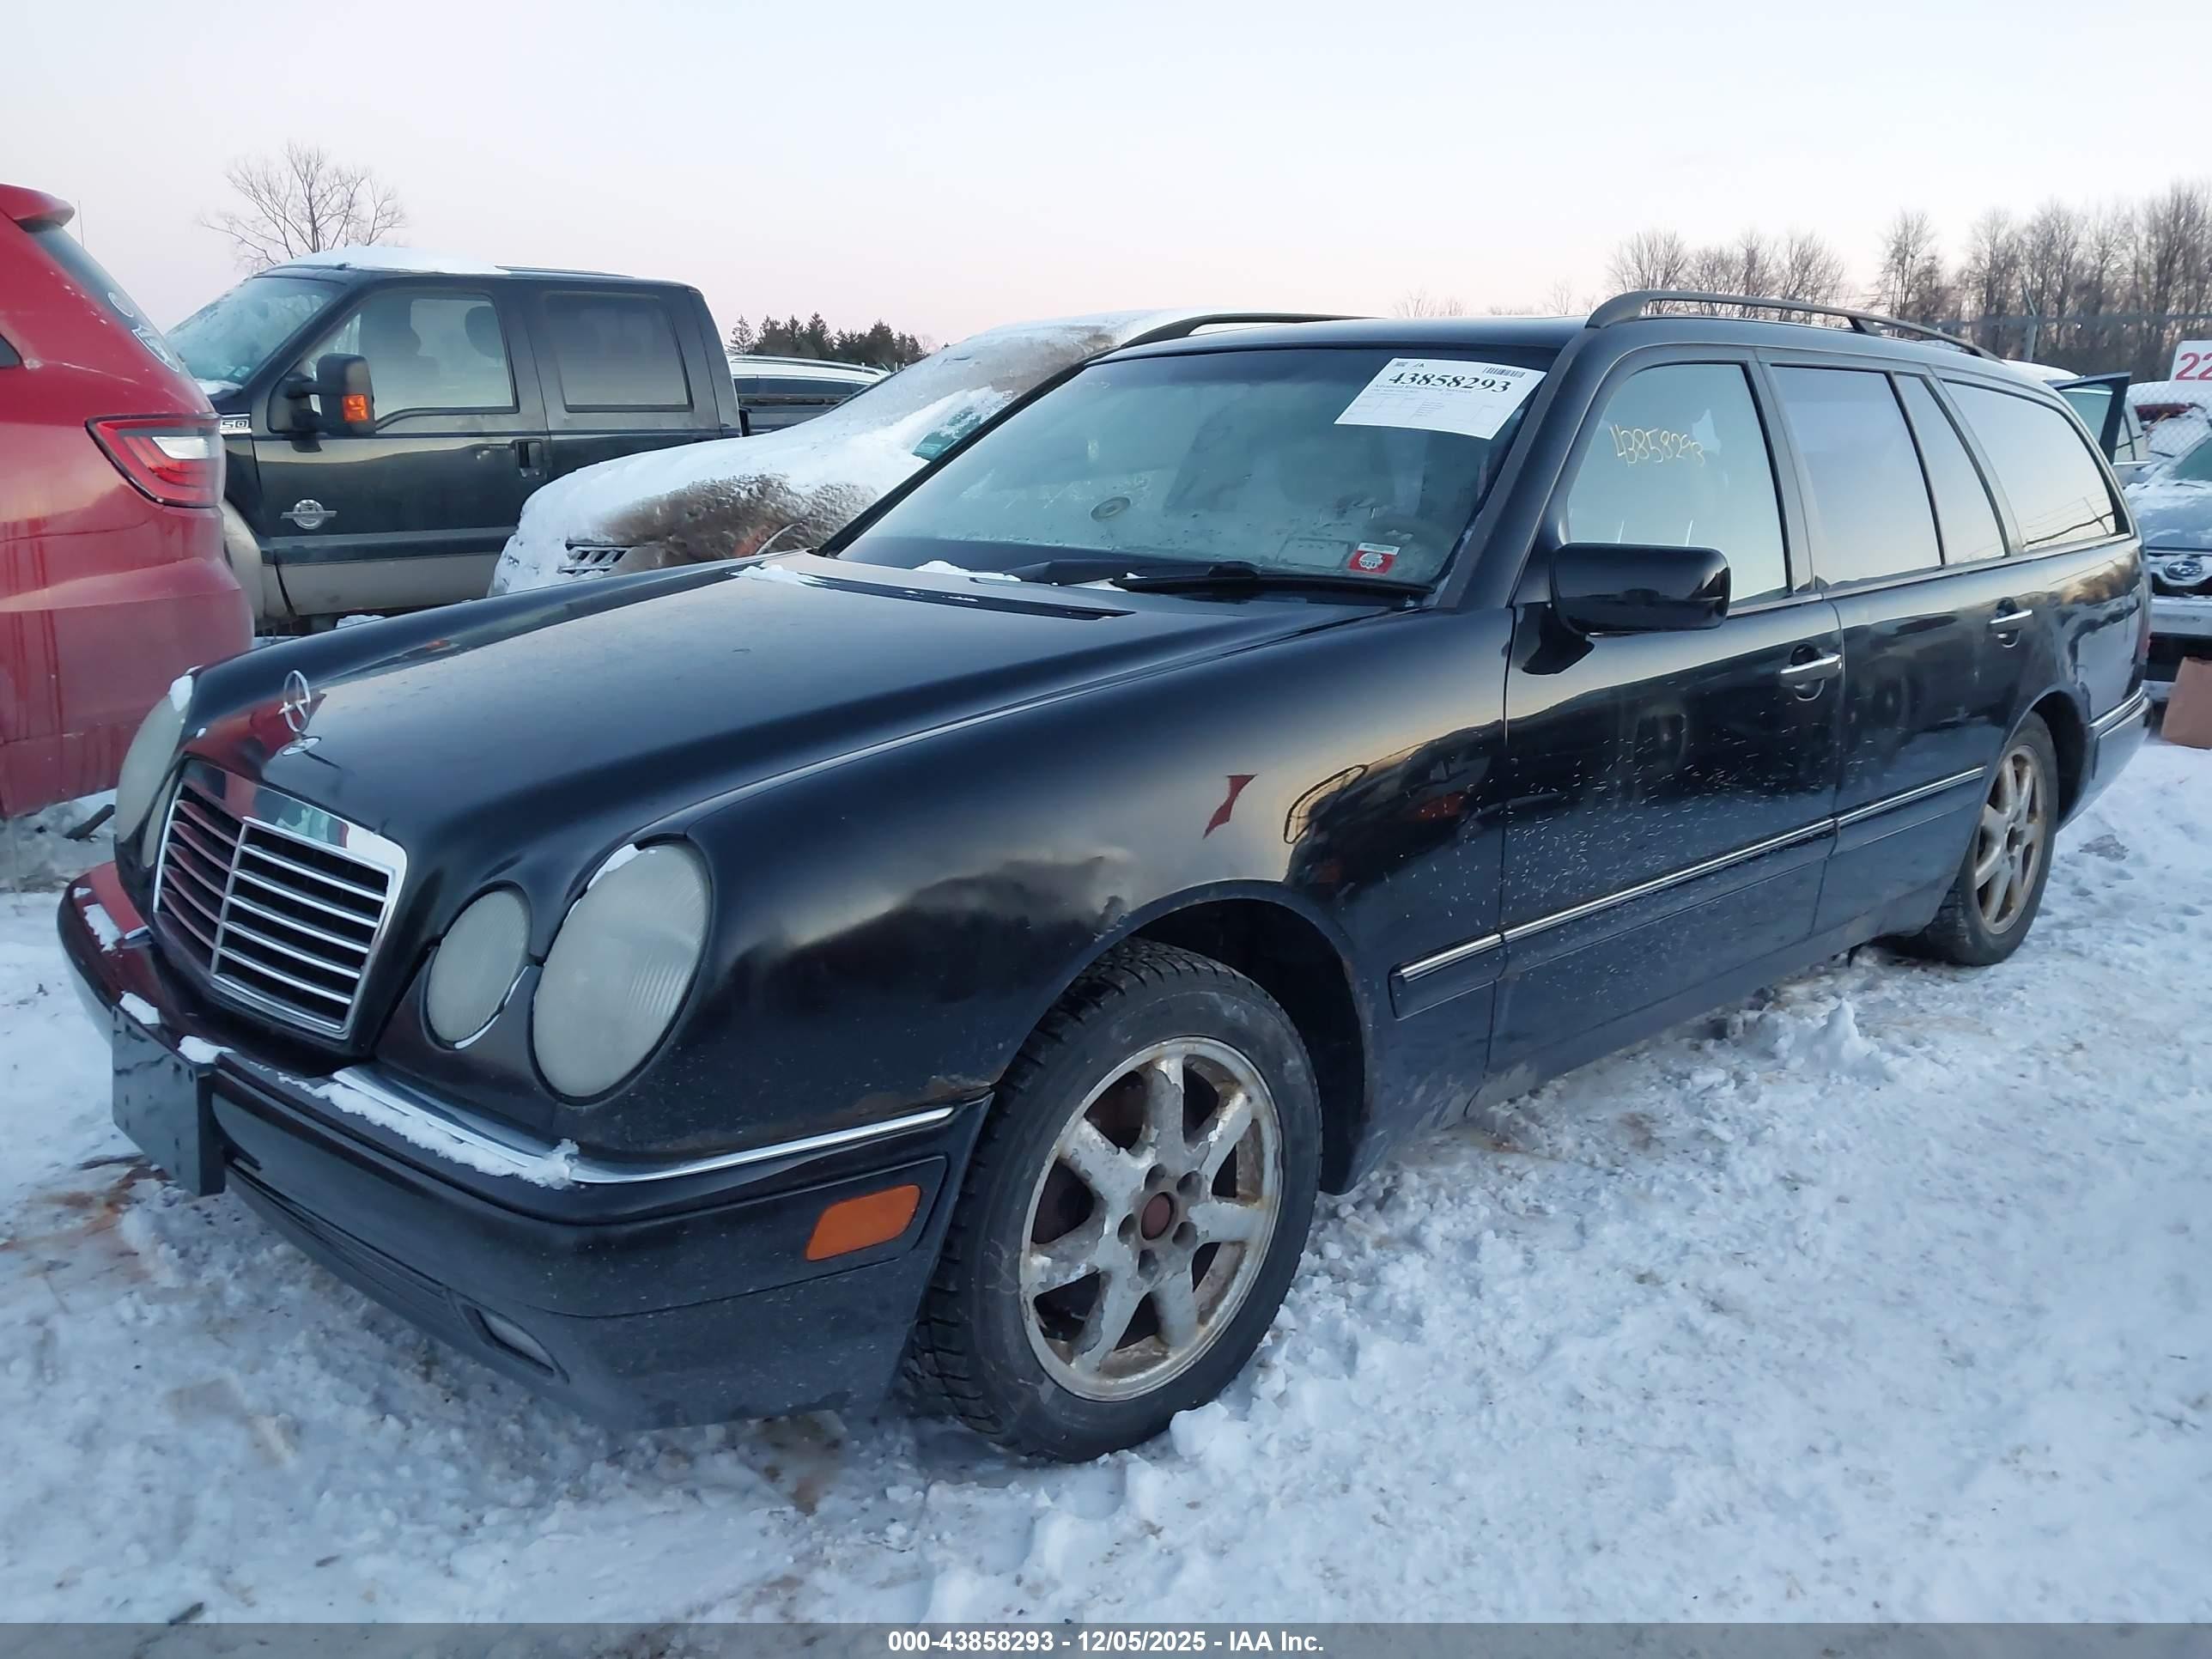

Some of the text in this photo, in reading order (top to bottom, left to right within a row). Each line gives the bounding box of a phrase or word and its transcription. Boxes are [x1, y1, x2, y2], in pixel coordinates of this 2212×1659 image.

[1388, 372, 1511, 393] 43858293
[222, 420, 248, 429] 50
[1609, 423, 1705, 467] 43858293
